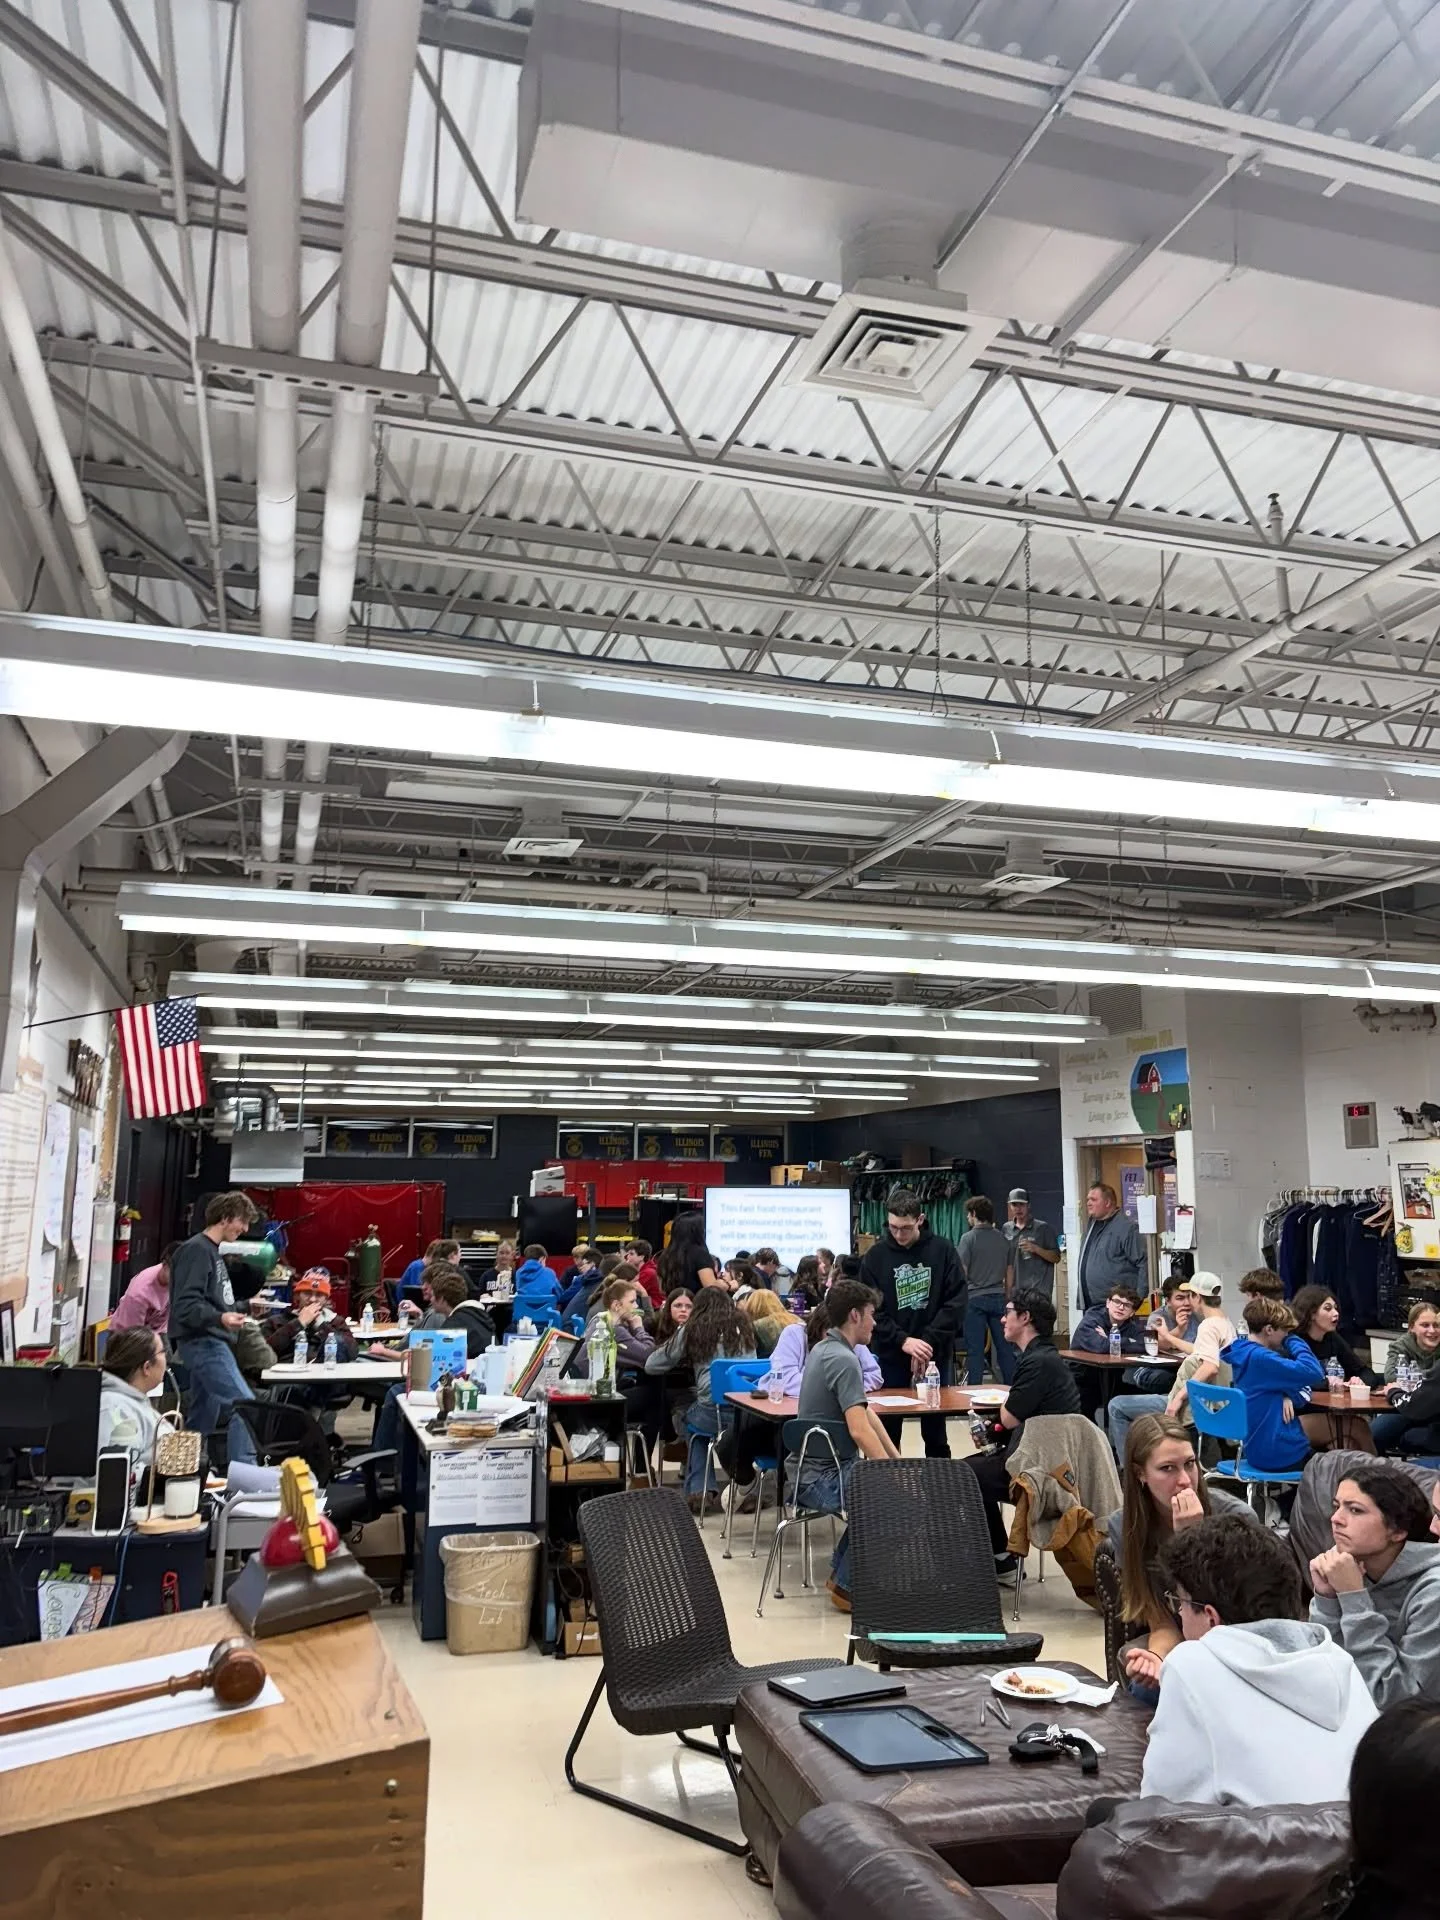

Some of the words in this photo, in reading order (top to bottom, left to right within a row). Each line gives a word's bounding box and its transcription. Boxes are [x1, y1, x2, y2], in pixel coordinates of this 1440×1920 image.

[368, 1132, 403, 1143] ILLINOIS
[454, 1134, 487, 1144] ILLINOIS
[598, 1135, 629, 1146] ILLINOIS
[674, 1137, 705, 1147] ILLINOIS
[378, 1143, 394, 1153] FFA
[463, 1144, 479, 1153] FFA
[750, 1139, 779, 1149] ILLINOIS
[607, 1146, 621, 1156] FFA
[683, 1148, 698, 1158] FFA
[758, 1149, 773, 1159] FFA
[721, 1203, 737, 1212] This
[739, 1203, 755, 1212] fast
[757, 1203, 777, 1212] food
[778, 1204, 822, 1212] restaurant
[738, 1218, 783, 1226] announced
[785, 1218, 801, 1226] that
[804, 1218, 823, 1228] they
[737, 1231, 746, 1240] be
[748, 1232, 783, 1241] shutting
[785, 1231, 808, 1240] down
[899, 1280, 929, 1296] ILLINOIS
[478, 1607, 504, 1625] Lab
